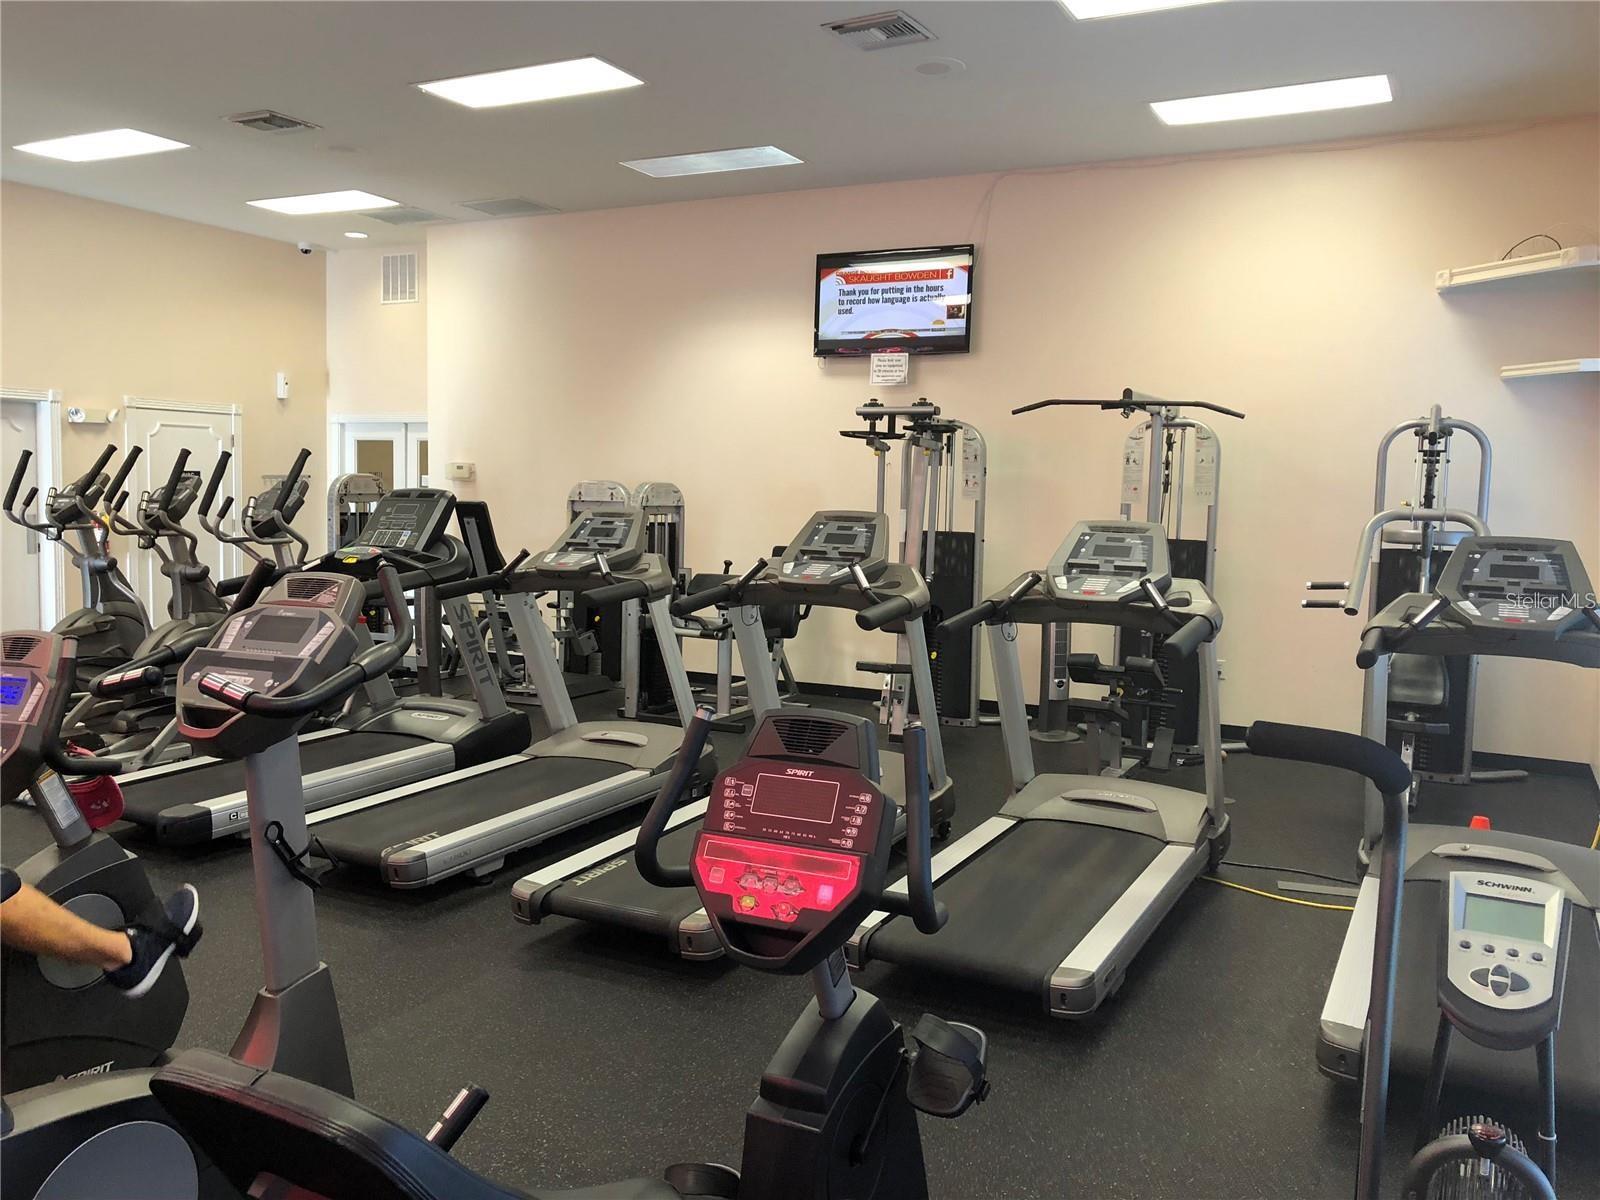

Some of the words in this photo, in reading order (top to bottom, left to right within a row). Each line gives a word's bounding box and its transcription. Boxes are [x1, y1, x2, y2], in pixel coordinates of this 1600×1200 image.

[849, 273, 891, 283] SKAUGHT
[894, 271, 937, 281] BOWDEN
[839, 288, 856, 297] Thank
[857, 289, 869, 298] you
[870, 287, 880, 295] for
[881, 286, 904, 296] putting
[905, 285, 912, 293] in
[913, 284, 925, 293] the
[925, 284, 944, 292] hours
[838, 298, 845, 306] to
[846, 297, 866, 306] record
[867, 296, 880, 305] how
[881, 294, 911, 305] language
[911, 294, 918, 303] is
[453, 602, 495, 686] SPIRIT
[785, 768, 815, 778] SPIRIT
[572, 859, 628, 887] SPIRIT
[1477, 880, 1533, 893] SCHWINN
